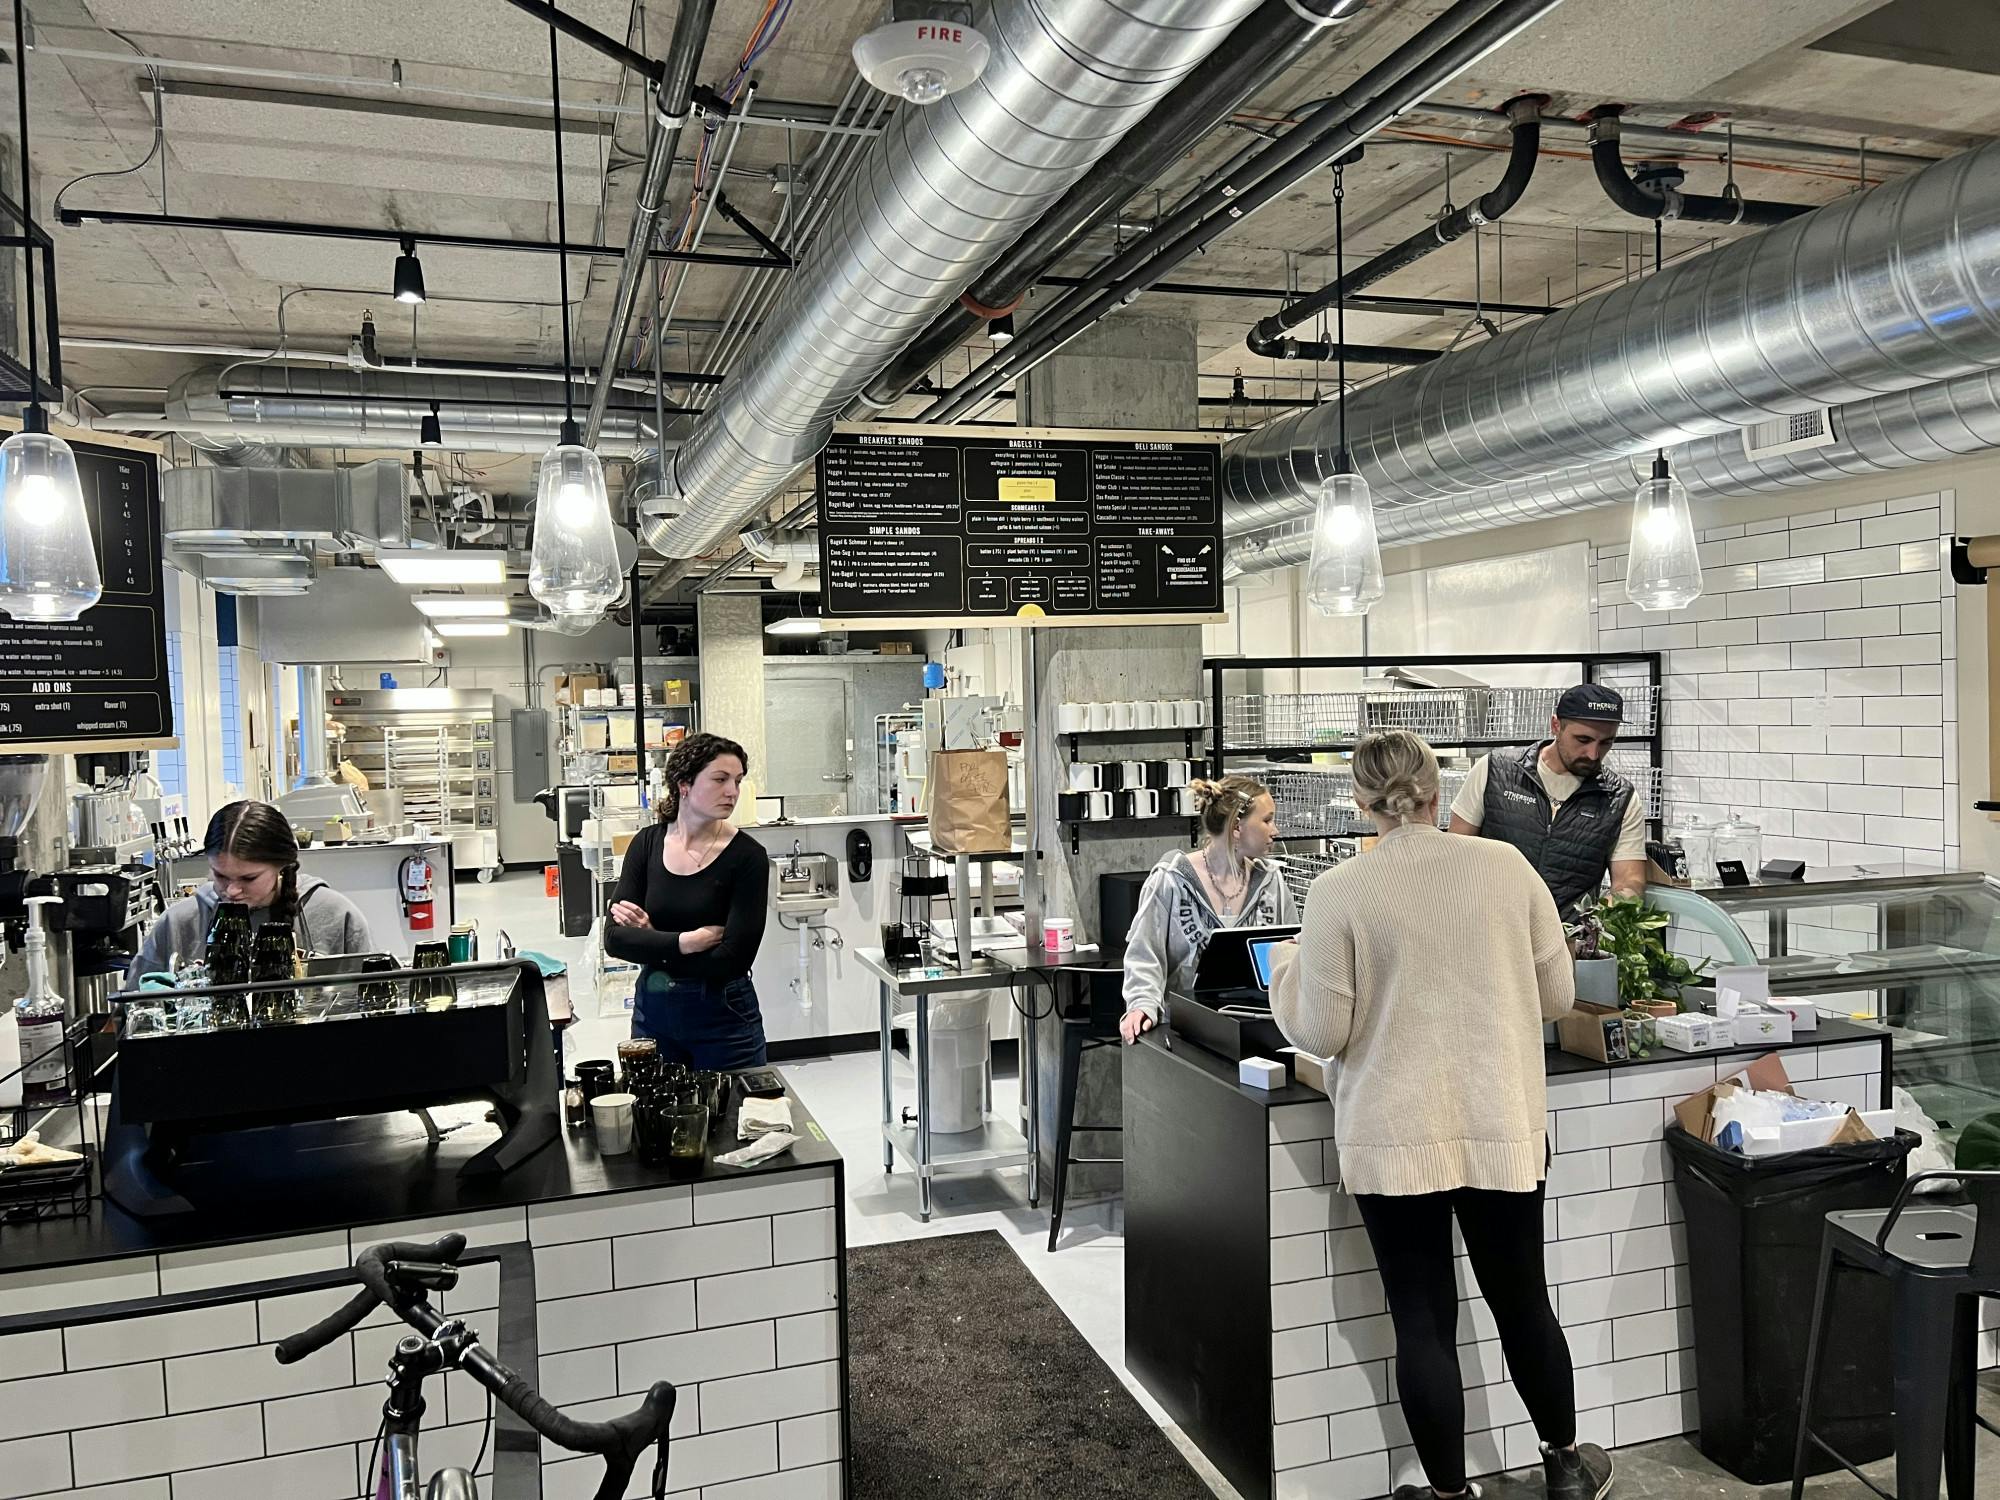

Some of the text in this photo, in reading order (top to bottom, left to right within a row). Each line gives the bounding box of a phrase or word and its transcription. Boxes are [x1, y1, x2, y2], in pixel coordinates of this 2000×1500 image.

[918, 26, 962, 43] FIRE
[859, 436, 924, 446] BREAKFAST SANDOS
[1009, 440, 1042, 449] BAGELS 2
[1135, 443, 1149, 451] DELI
[828, 501, 842, 509] Bagel
[842, 501, 855, 509] Bagel
[123, 511, 131, 519] 4.5
[869, 526, 921, 535] SIMPLE SANDOS
[1138, 528, 1175, 536] TAKE-AWAYS
[32, 682, 72, 693] ADD ONS
[35, 703, 50, 711] extra
[50, 702, 62, 711] shot
